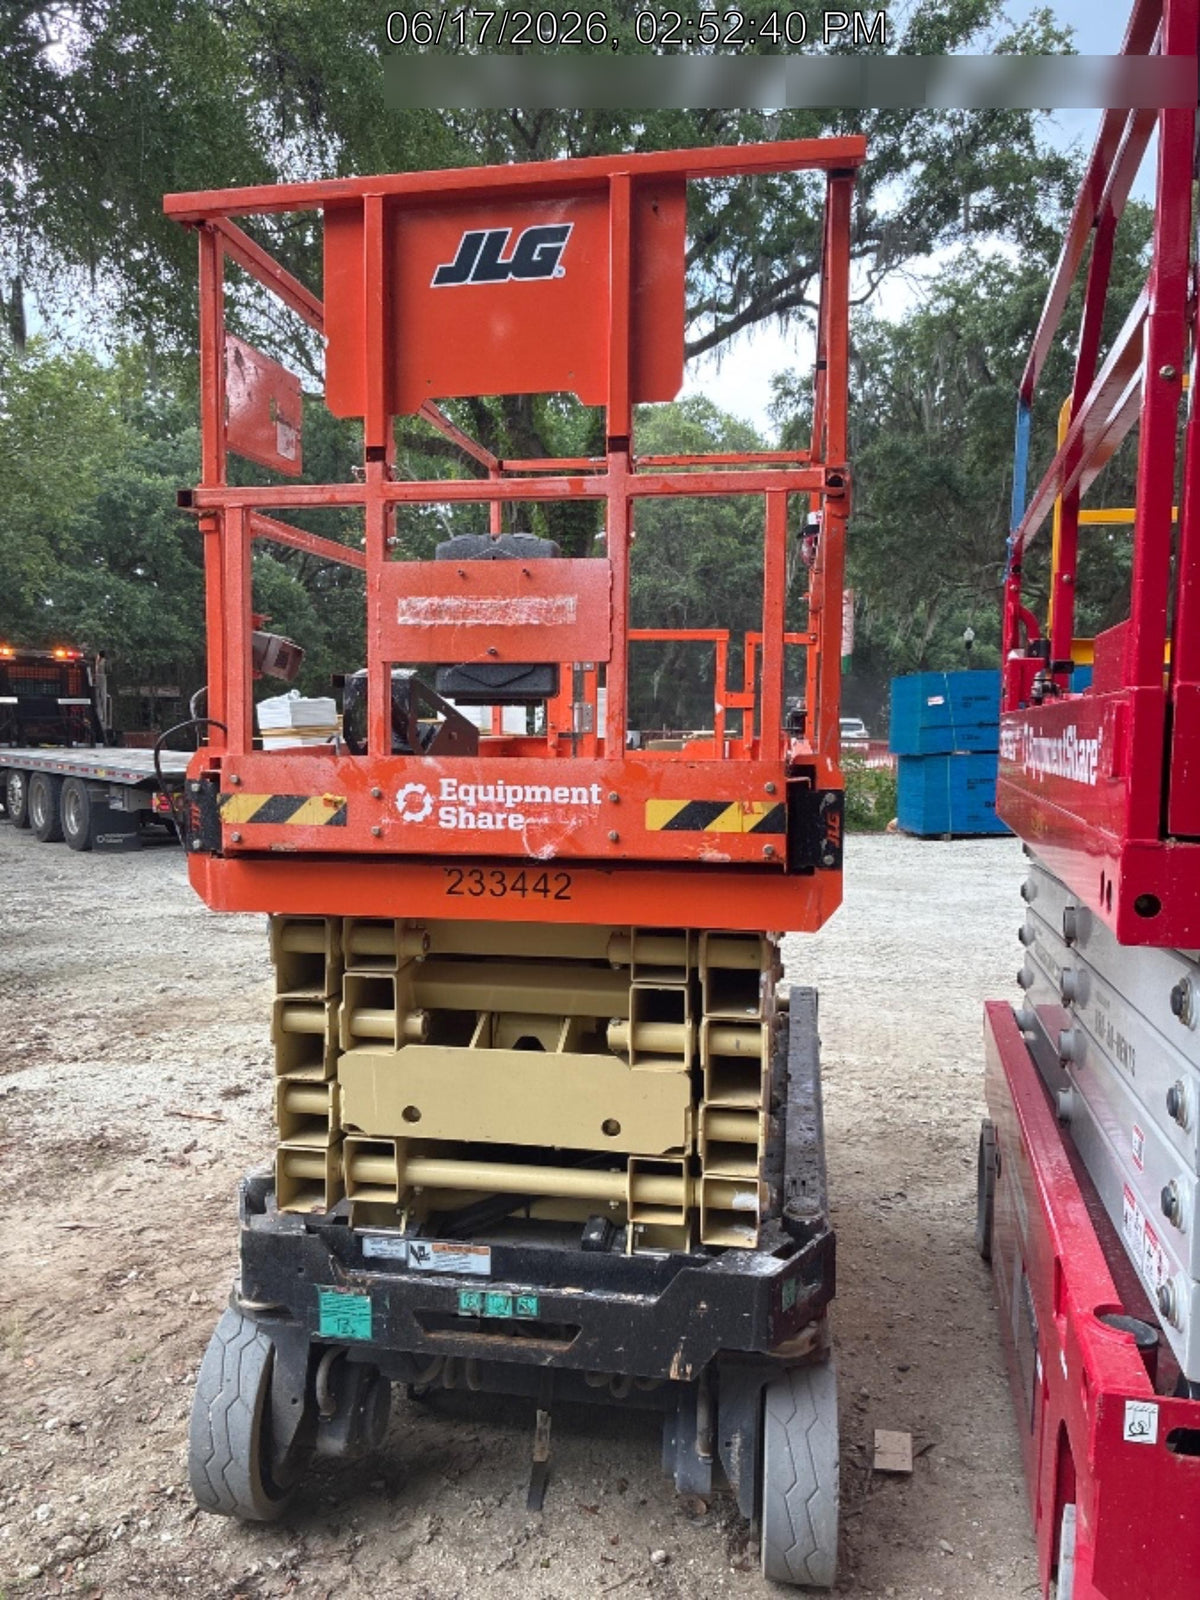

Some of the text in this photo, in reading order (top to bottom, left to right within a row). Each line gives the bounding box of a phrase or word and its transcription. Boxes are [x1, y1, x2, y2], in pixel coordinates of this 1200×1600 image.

[430, 222, 574, 288] JLG
[439, 778, 602, 807] Equipment
[438, 806, 525, 830] Share
[446, 868, 572, 900] 233442
